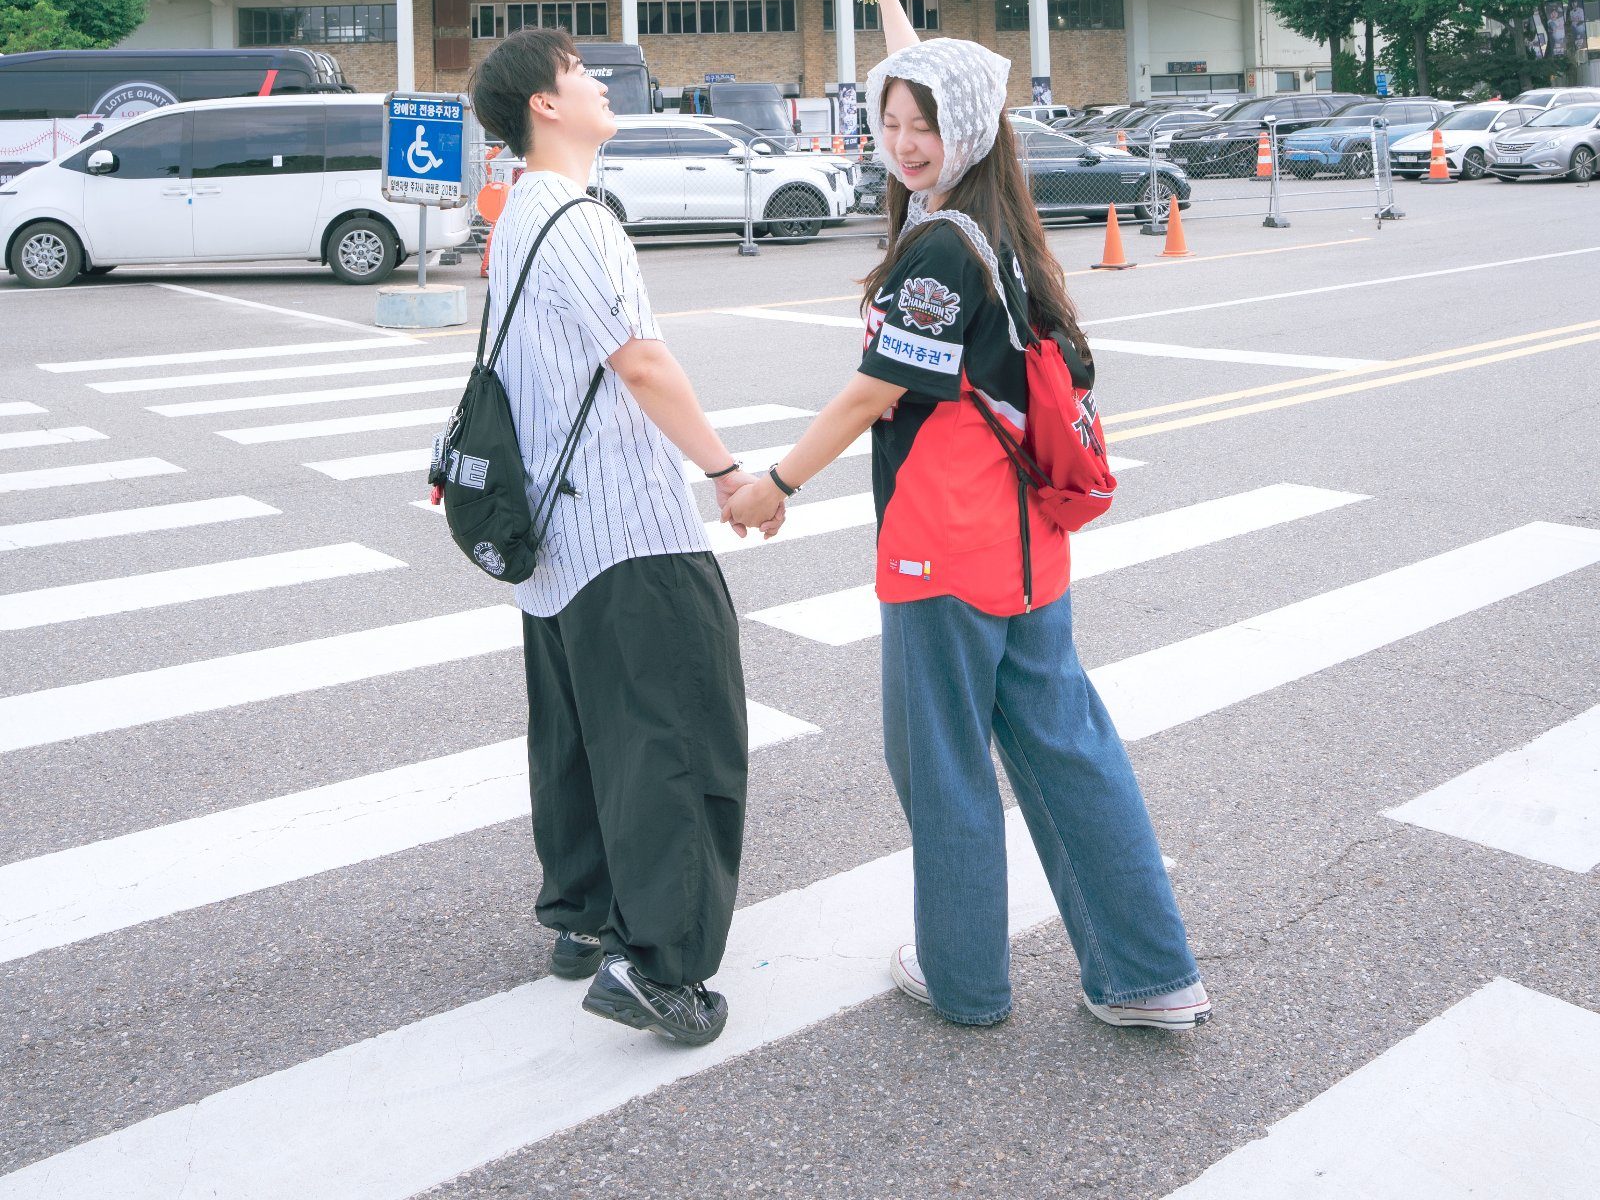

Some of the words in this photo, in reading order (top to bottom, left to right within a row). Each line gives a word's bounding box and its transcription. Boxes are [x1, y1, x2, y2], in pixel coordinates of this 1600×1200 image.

[105, 90, 134, 111] LOTTE
[136, 90, 171, 108] GIANT
[393, 102, 417, 116] 장애인
[900, 292, 957, 322] CHAMPIONS
[882, 334, 941, 365] 현대차증권
